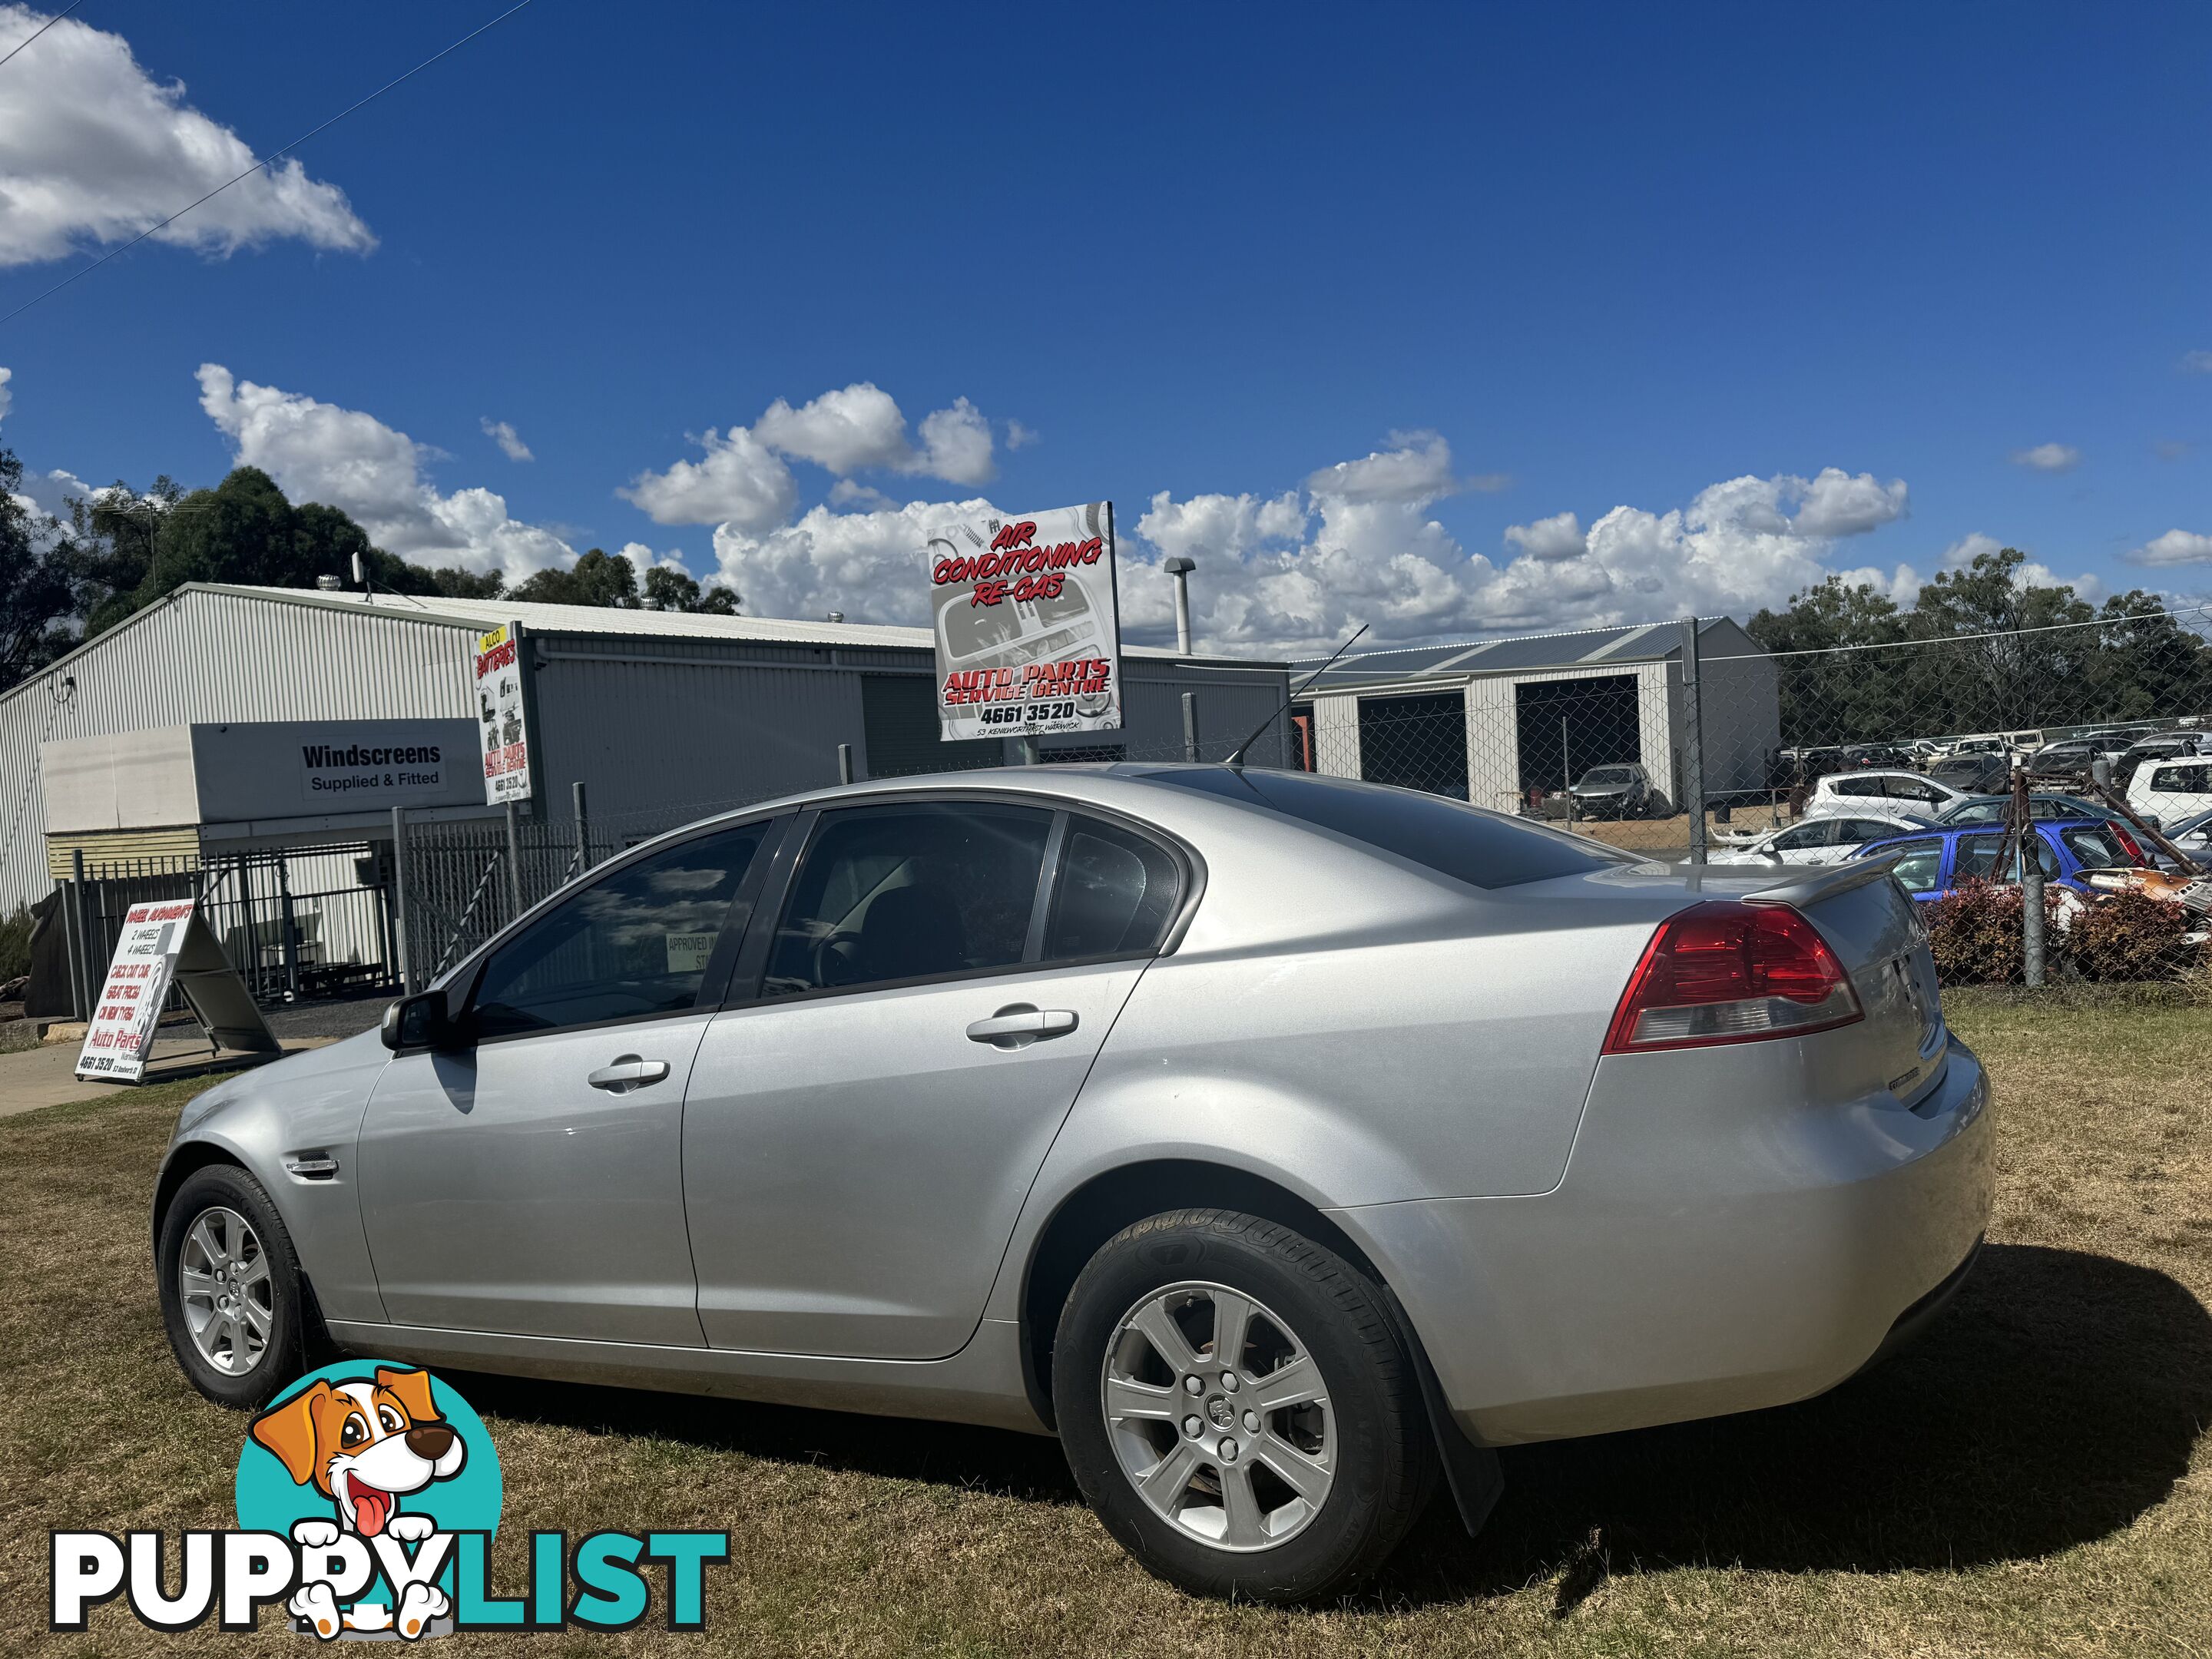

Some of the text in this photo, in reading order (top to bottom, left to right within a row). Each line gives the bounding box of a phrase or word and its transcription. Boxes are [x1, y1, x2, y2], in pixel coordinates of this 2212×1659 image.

[991, 521, 1038, 551] AIR
[933, 536, 1103, 584] CONDITIONING
[971, 571, 1065, 608] RE-GAS
[485, 630, 500, 649] ALCO
[477, 638, 515, 680] BATTERIES
[943, 657, 1111, 694] AUTO PARTS
[944, 677, 1111, 707] SERVICE CENTRE
[981, 702, 1074, 724] 4661 3520
[1045, 720, 1080, 730] WARWICK
[303, 744, 441, 768] Windscreens
[485, 750, 502, 768] AUTO
[311, 771, 439, 793] Supplied & Fitted
[495, 776, 518, 792] 4661 3520
[126, 904, 194, 924] WHEEL ALIGNMENTS
[131, 929, 161, 941] 2 WHEELS
[669, 937, 707, 951] APPROVED
[127, 944, 155, 955] 4 WHEELS
[111, 964, 151, 979] CHECK OUT OUR
[91, 1030, 141, 1050] Auto Parts
[80, 1056, 114, 1071] 4661 3520
